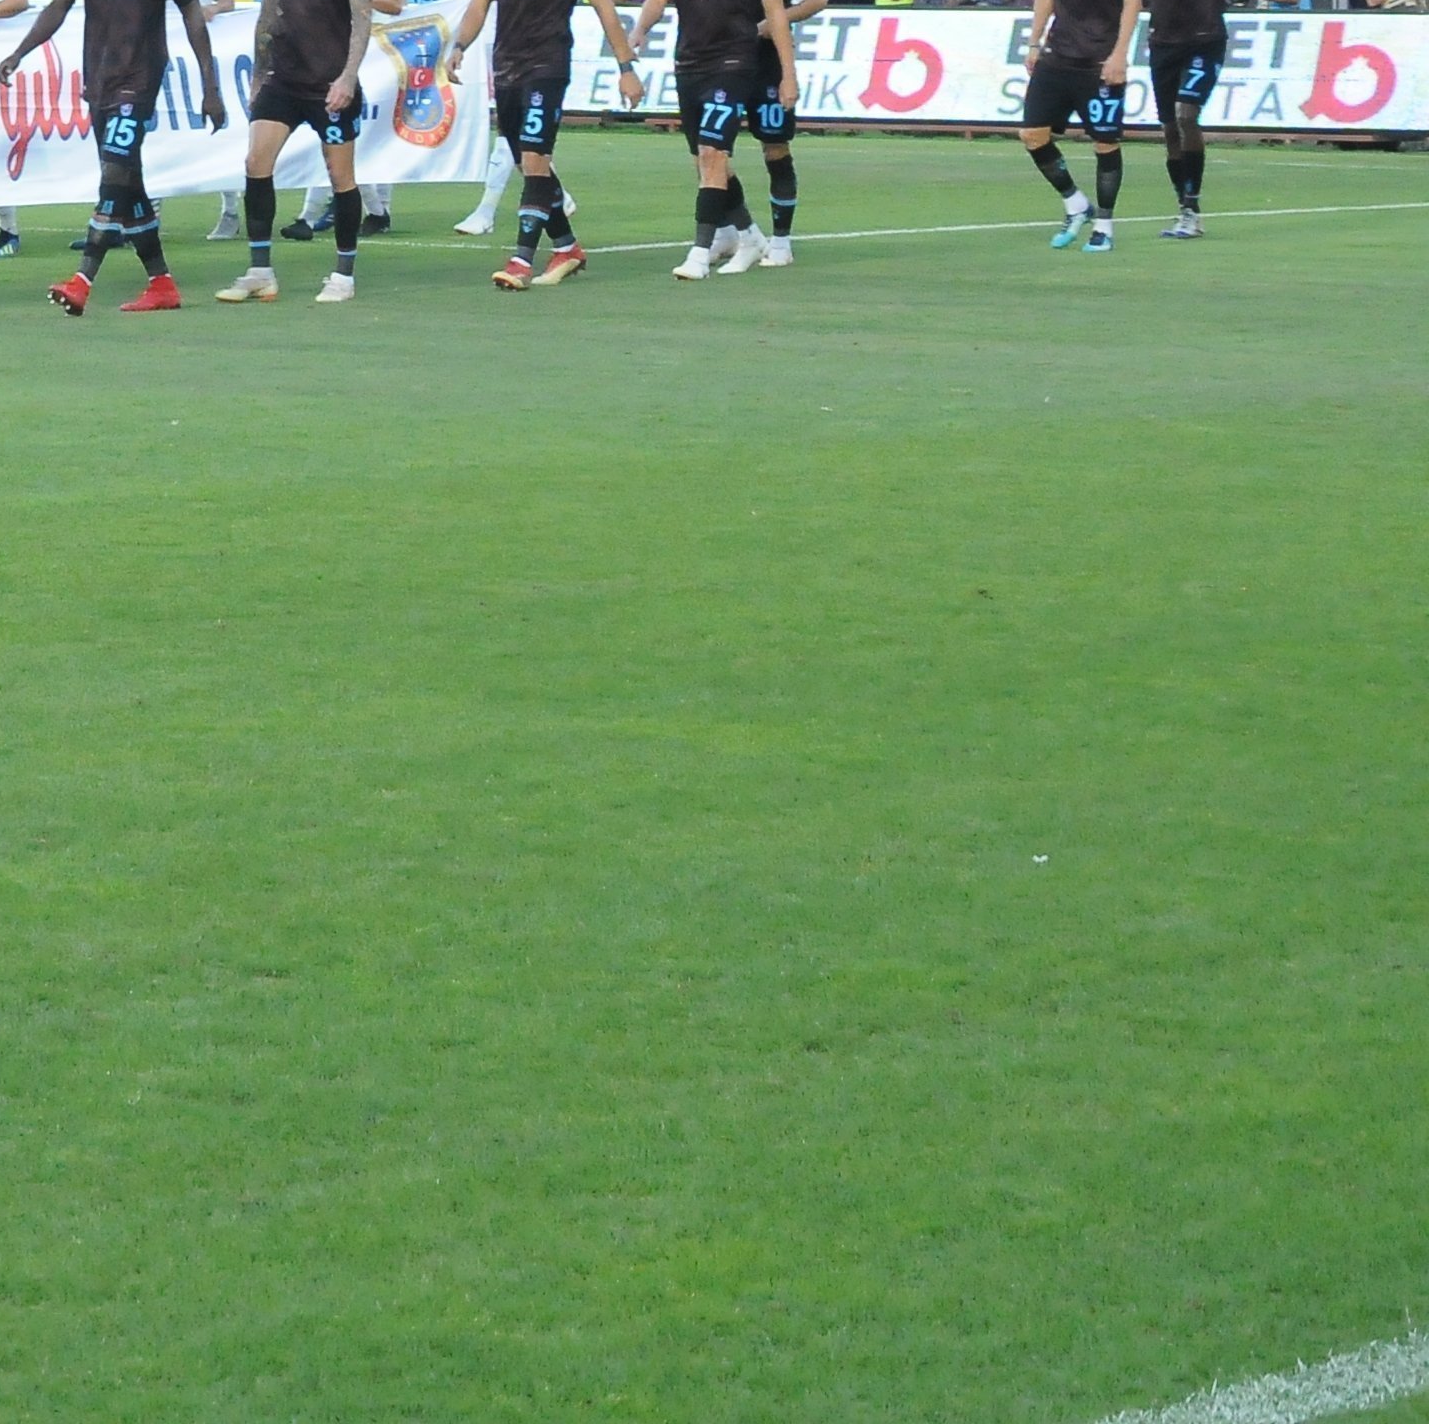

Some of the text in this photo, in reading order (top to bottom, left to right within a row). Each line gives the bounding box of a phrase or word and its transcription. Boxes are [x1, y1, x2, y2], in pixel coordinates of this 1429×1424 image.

[1188, 69, 1205, 89] 7
[524, 108, 544, 135] 5
[757, 103, 784, 128] 10
[1088, 98, 1120, 123] 97
[106, 116, 138, 147] 15
